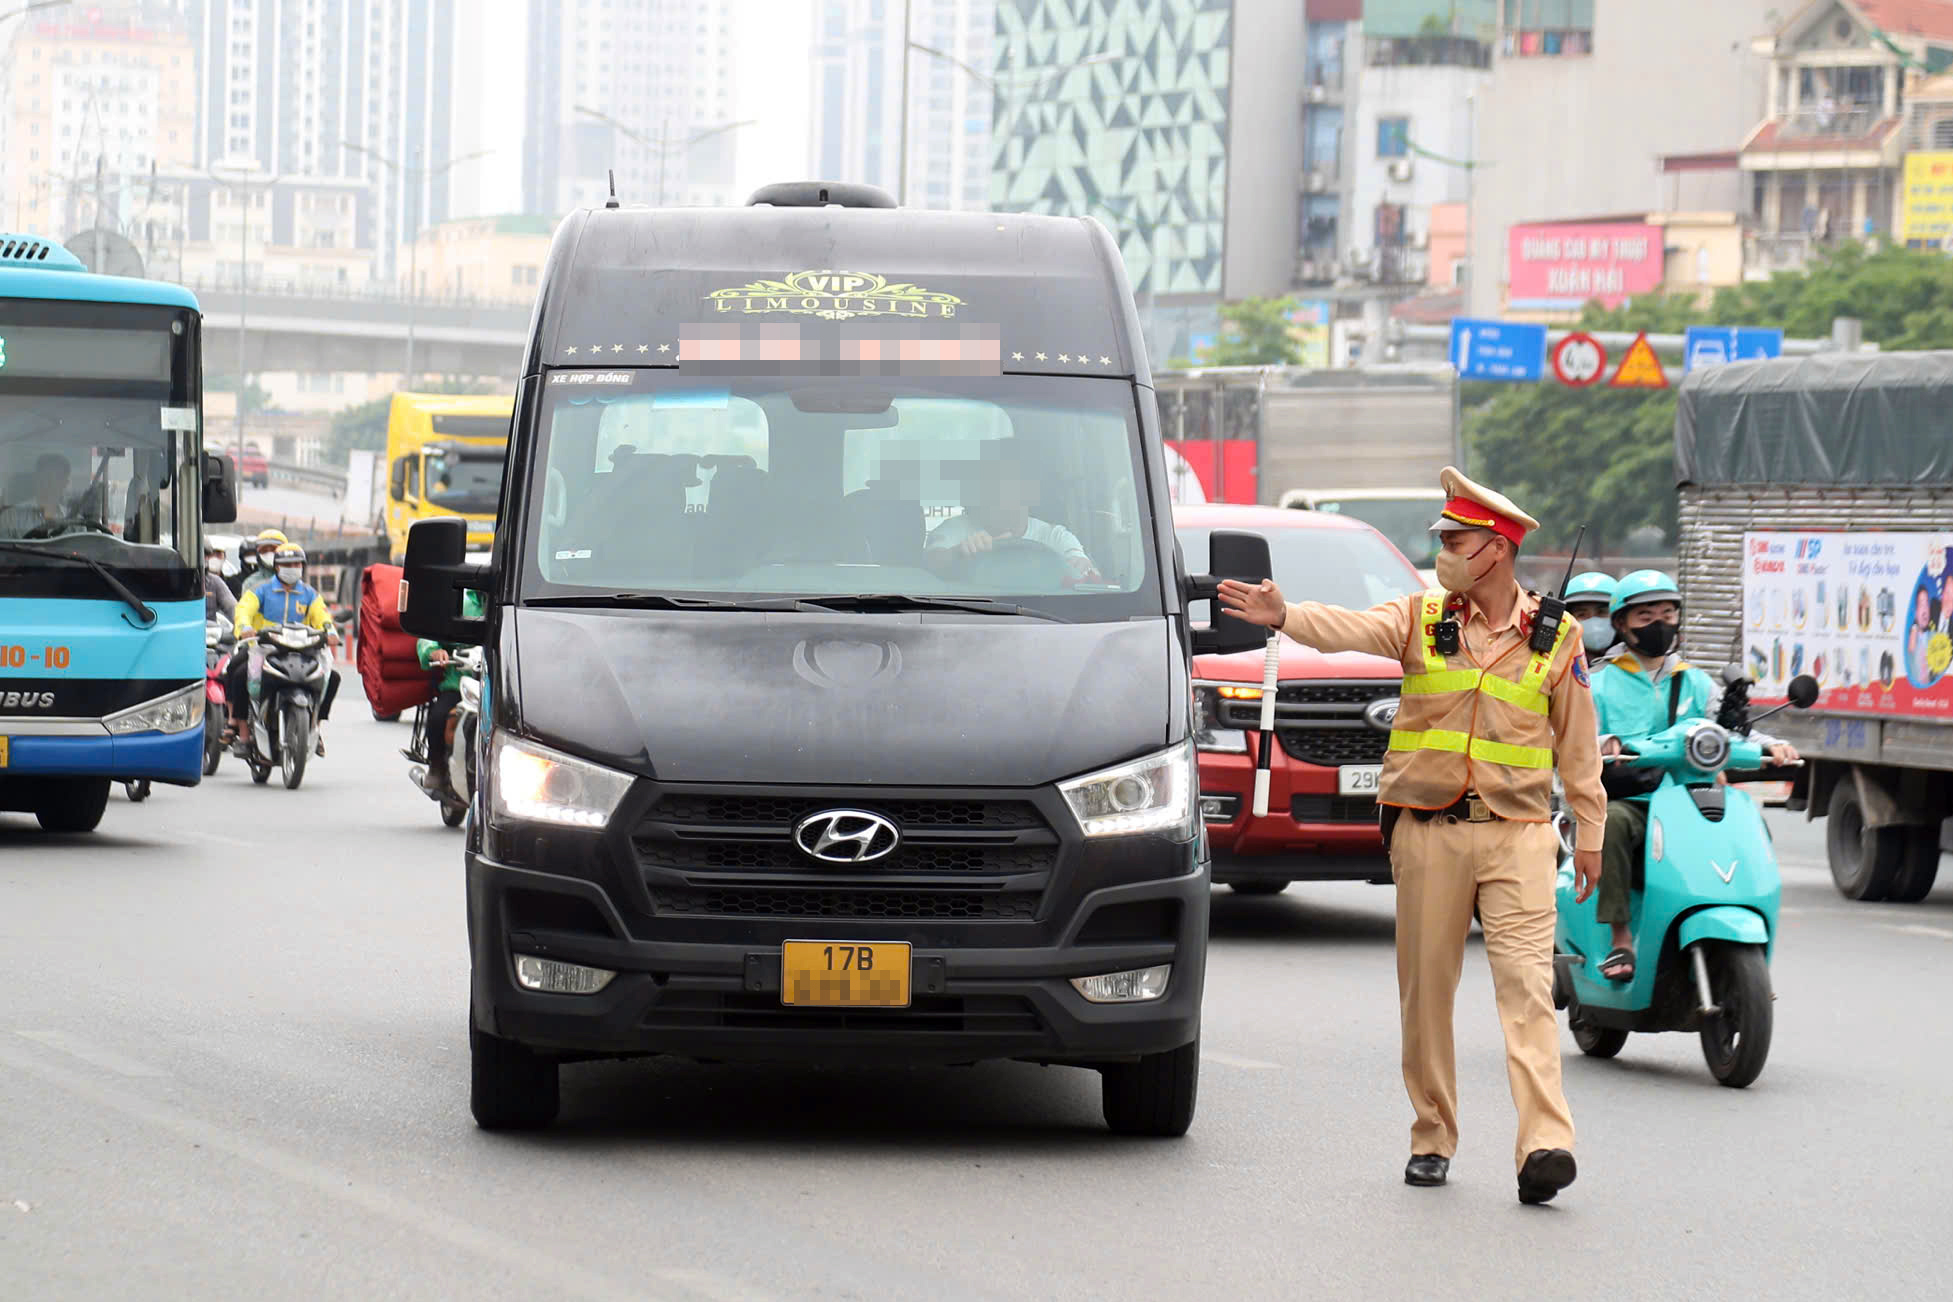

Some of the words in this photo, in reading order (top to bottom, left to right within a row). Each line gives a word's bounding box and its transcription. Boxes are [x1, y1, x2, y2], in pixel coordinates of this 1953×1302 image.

[807, 276, 865, 292] VIP
[716, 296, 956, 318] LIMOUSINE
[551, 374, 567, 383] XE
[0, 691, 55, 708] BUS
[823, 946, 873, 971] 17B
